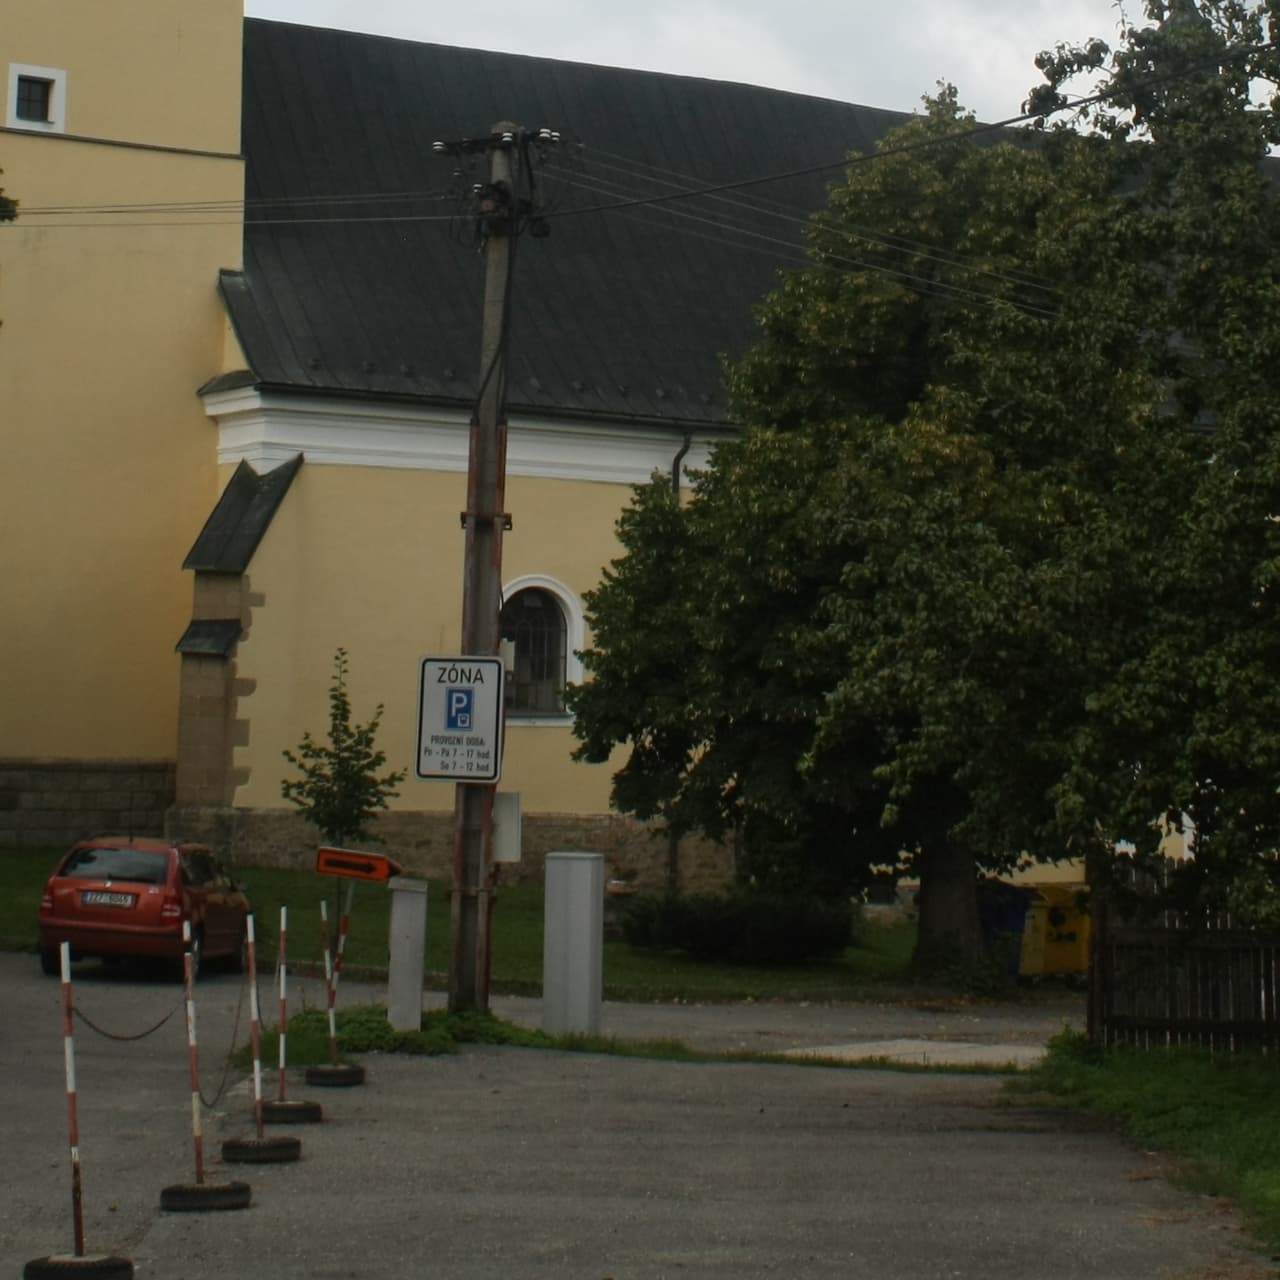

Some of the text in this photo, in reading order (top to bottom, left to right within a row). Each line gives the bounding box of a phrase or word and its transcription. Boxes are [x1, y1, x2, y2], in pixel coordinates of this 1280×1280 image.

[437, 663, 485, 684] ZÓNA
[451, 692, 468, 717] P
[453, 748, 457, 758] 7
[467, 748, 474, 758] 17
